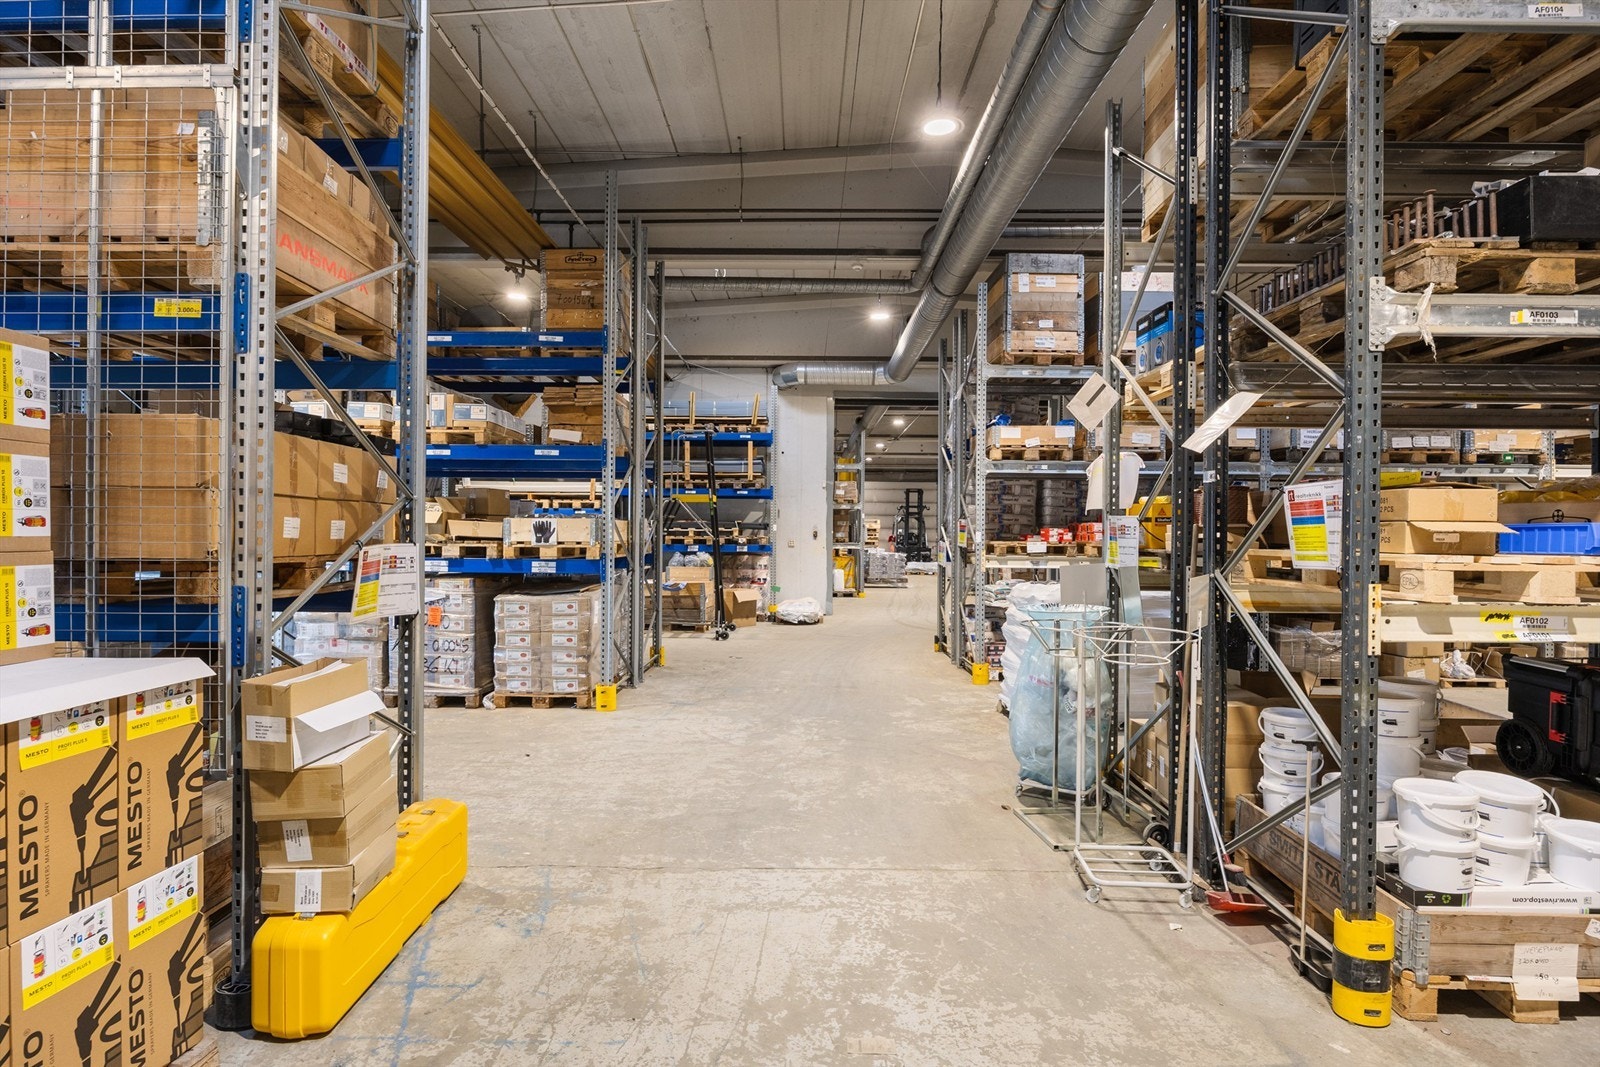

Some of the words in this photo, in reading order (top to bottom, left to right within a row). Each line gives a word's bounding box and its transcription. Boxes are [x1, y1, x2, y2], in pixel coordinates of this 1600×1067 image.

[25, 748, 49, 759] MESTO
[127, 761, 143, 871] MESTO
[18, 794, 39, 921] MESTO
[133, 925, 152, 938] MESTO
[29, 981, 53, 997] MESTO
